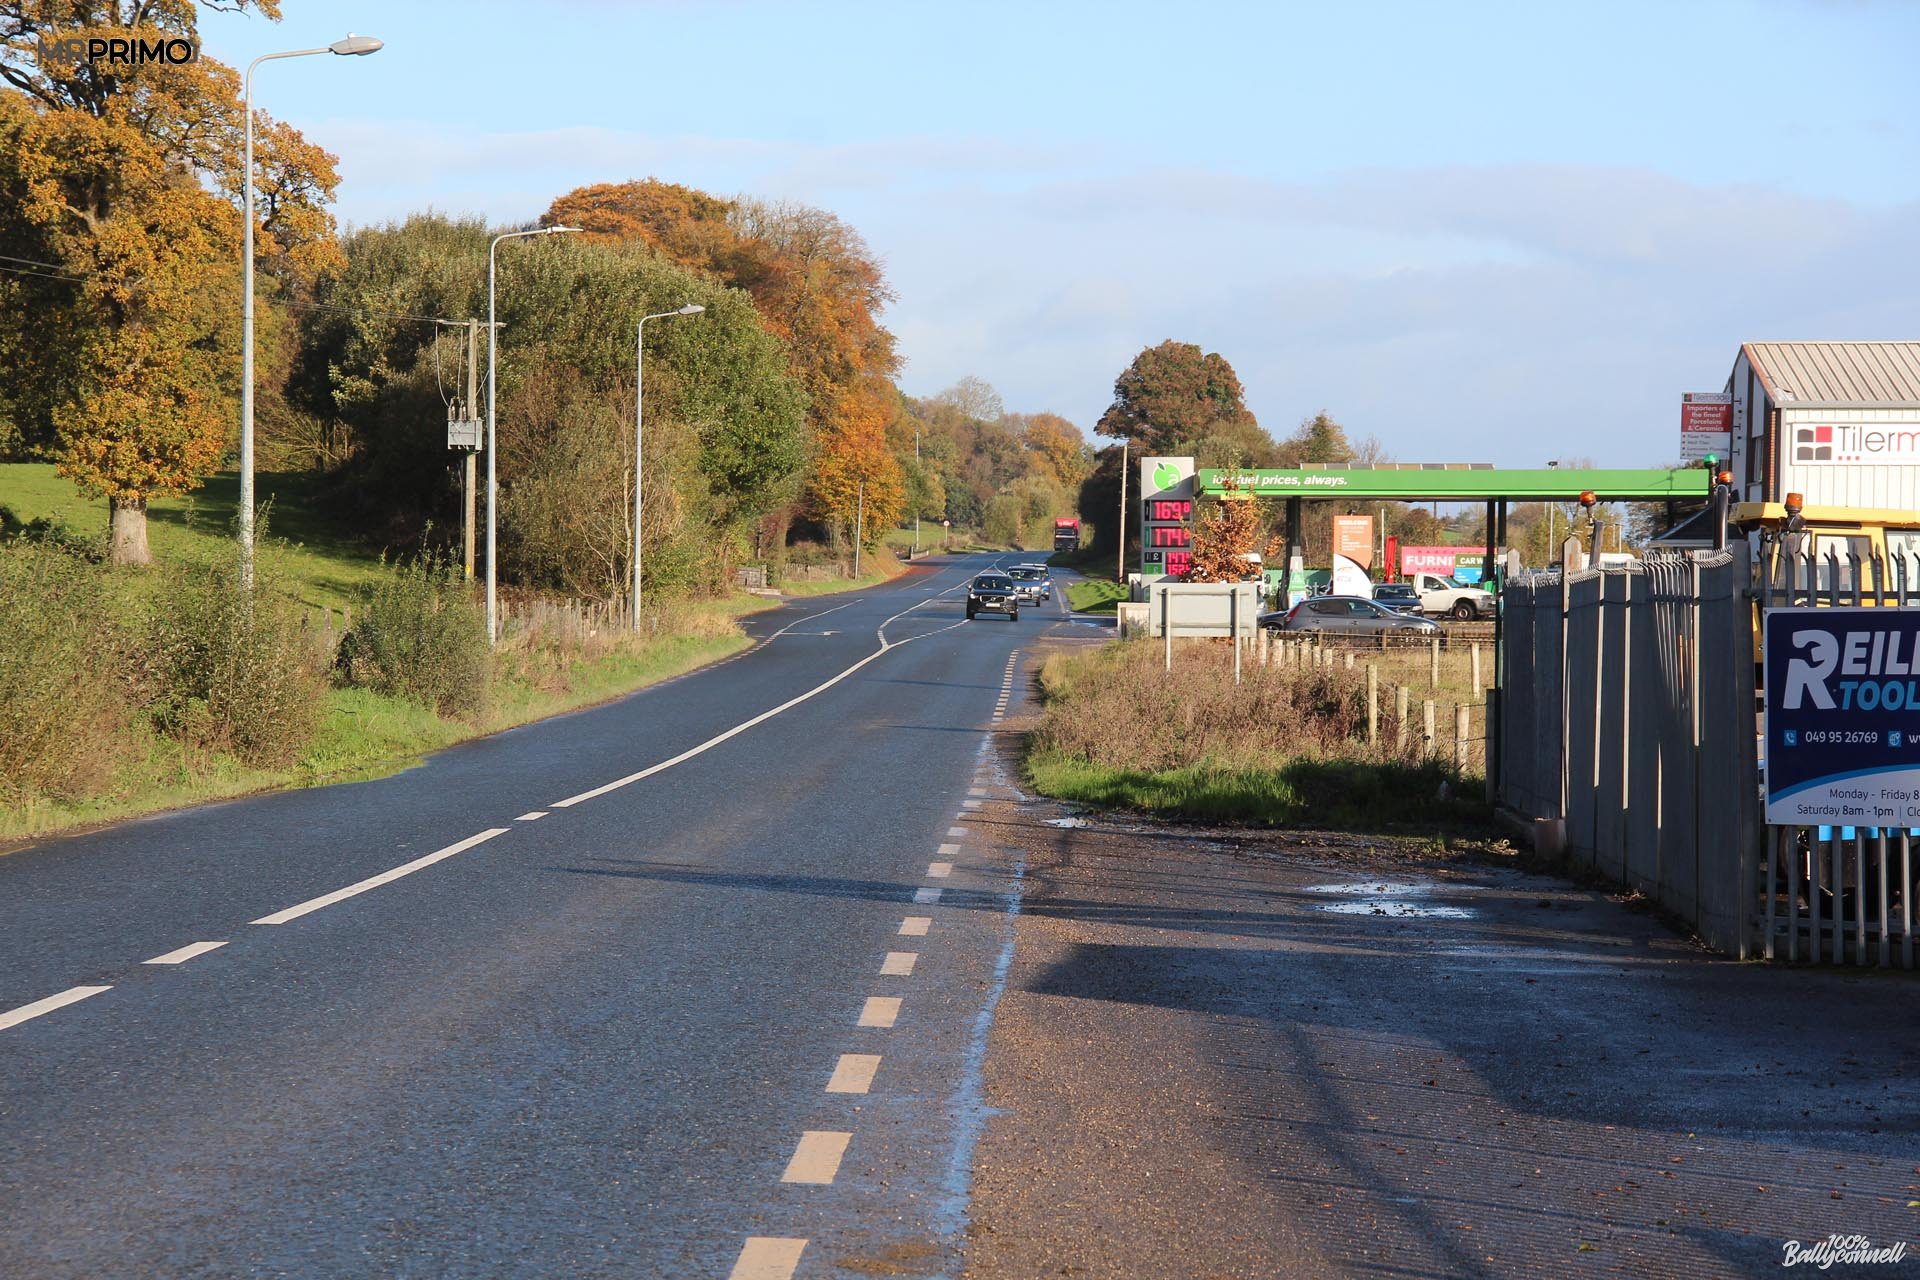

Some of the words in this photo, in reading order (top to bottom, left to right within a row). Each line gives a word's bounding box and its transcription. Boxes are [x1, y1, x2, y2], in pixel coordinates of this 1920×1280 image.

[1236, 475, 1259, 485] fuel
[1261, 475, 1301, 487] prices,
[1303, 474, 1348, 487] always.
[1460, 557, 1476, 565] CAR
[1805, 731, 1826, 743] 049
[1828, 731, 1842, 743] 95
[1844, 731, 1878, 744] 26769
[1829, 789, 1869, 801] Monday
[1881, 790, 1911, 801] Friday
[1797, 804, 1840, 816] Saturday
[1842, 805, 1864, 816] 8am
[1874, 806, 1894, 818] 1pm
